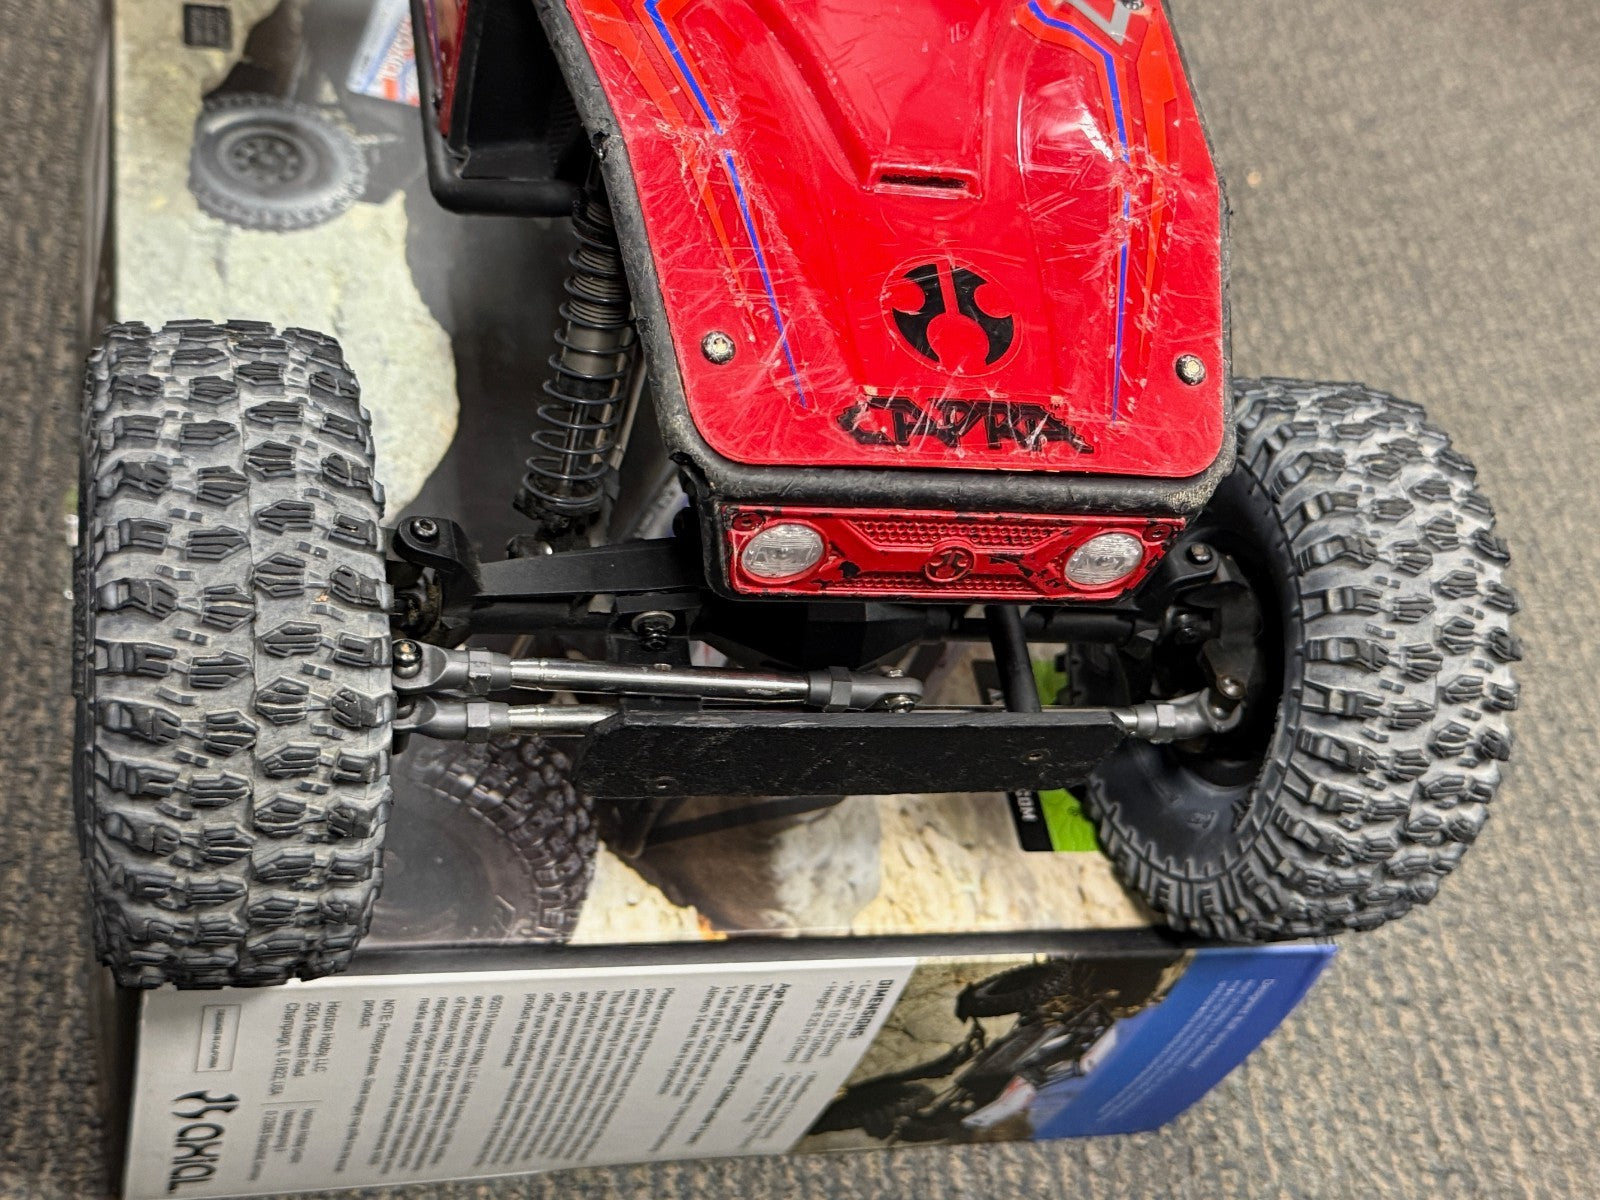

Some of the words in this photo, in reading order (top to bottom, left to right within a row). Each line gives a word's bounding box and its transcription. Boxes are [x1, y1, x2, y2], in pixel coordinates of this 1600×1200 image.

[754, 984, 773, 1000] This
[774, 983, 789, 998] Age
[304, 1002, 320, 1022] 2904
[321, 1001, 340, 1031] Horizon
[743, 1010, 758, 1022] not
[297, 1023, 316, 1057] Research
